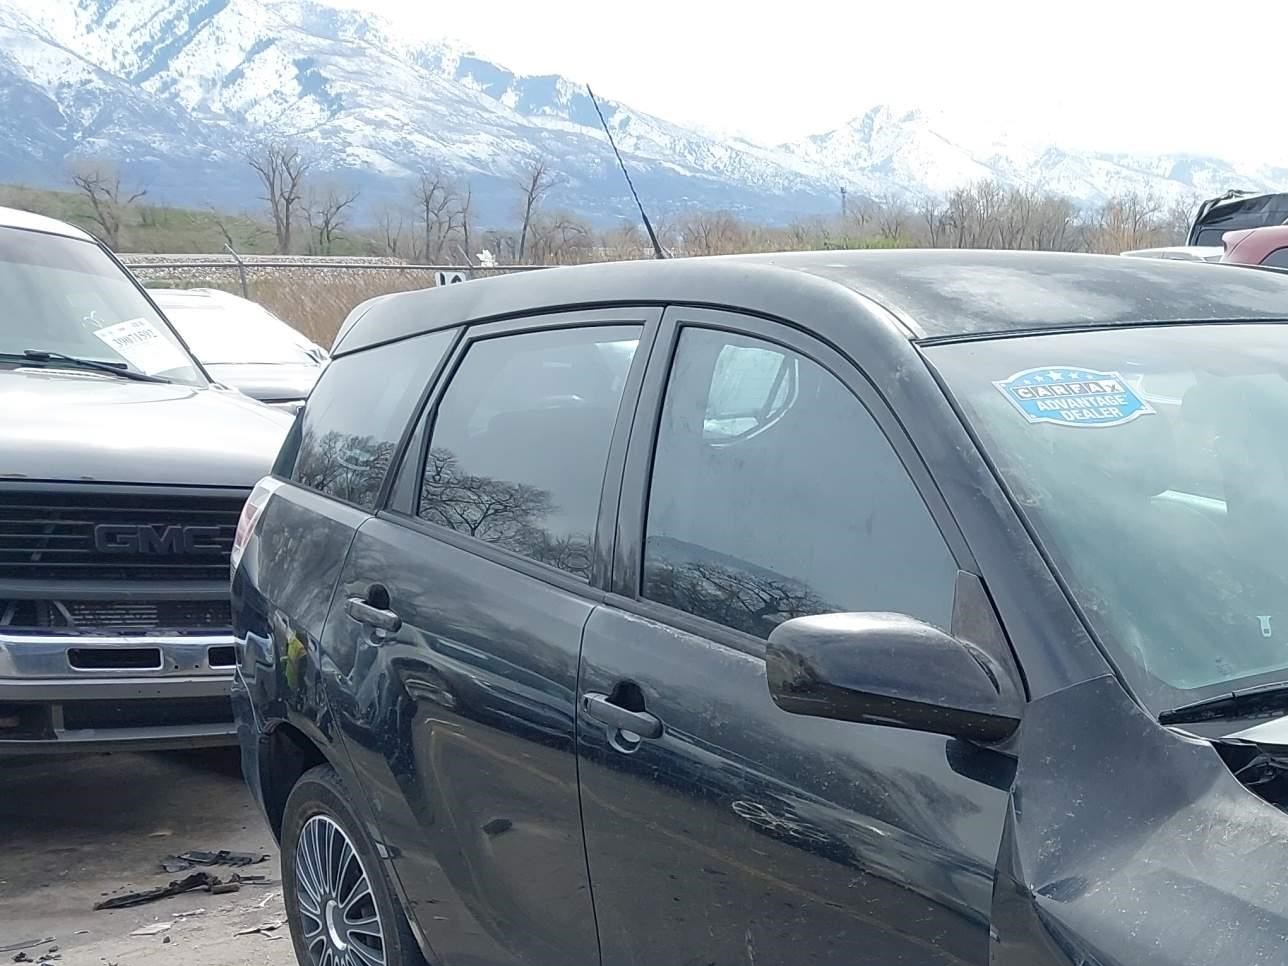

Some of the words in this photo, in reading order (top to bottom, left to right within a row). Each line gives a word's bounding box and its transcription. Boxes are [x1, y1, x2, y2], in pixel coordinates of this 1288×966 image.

[1016, 381, 1124, 399] CARFAX
[1036, 395, 1129, 411] ADVANTAGE
[1060, 407, 1124, 421] DEALER
[95, 524, 222, 554] GMC
